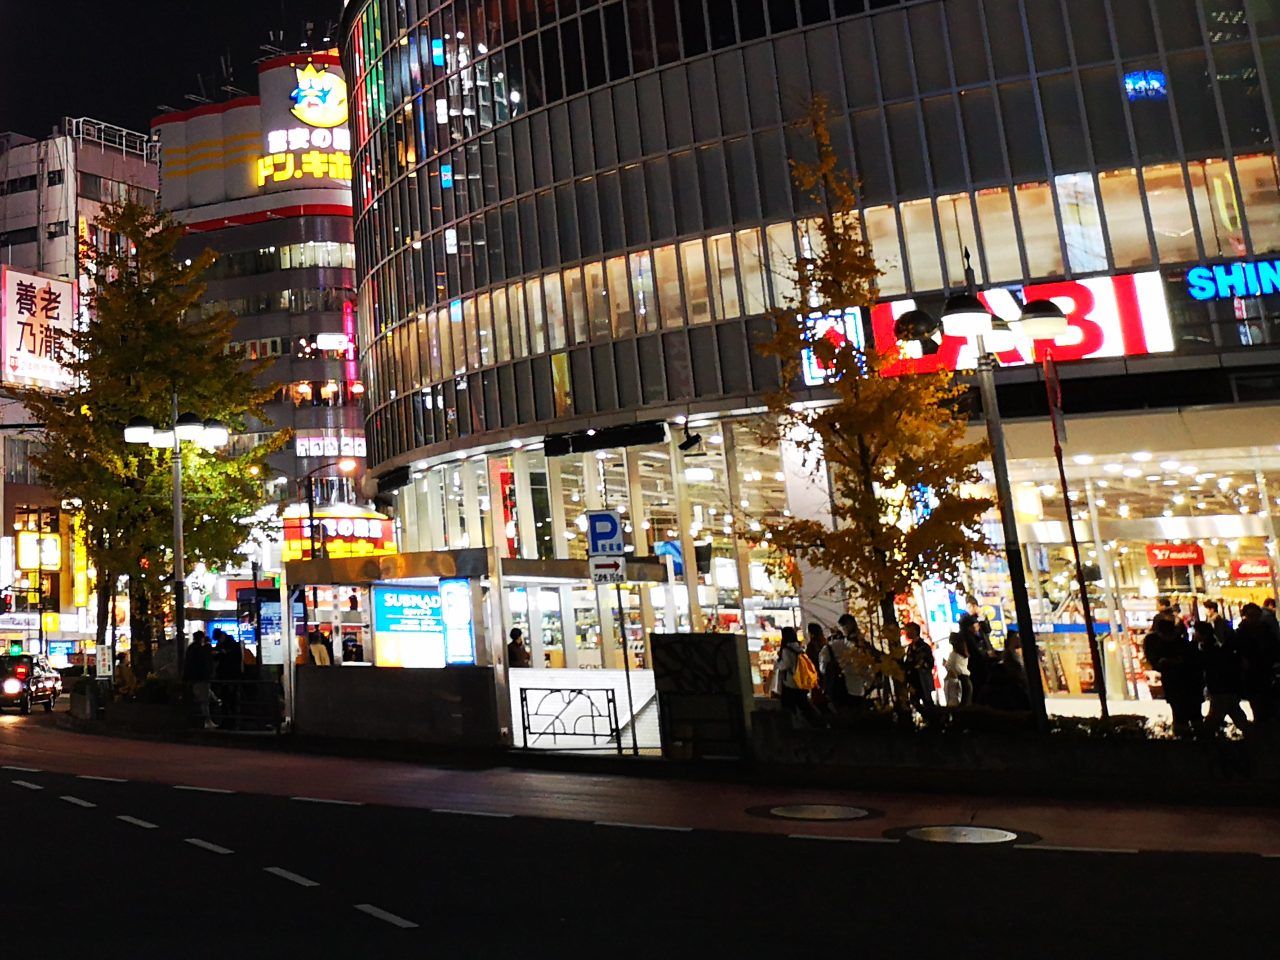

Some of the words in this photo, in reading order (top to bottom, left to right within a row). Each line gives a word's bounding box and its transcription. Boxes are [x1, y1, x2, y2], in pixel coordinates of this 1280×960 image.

[1187, 260, 1280, 300] SHIN
[16, 280, 61, 321] 養老
[589, 514, 619, 553] P
